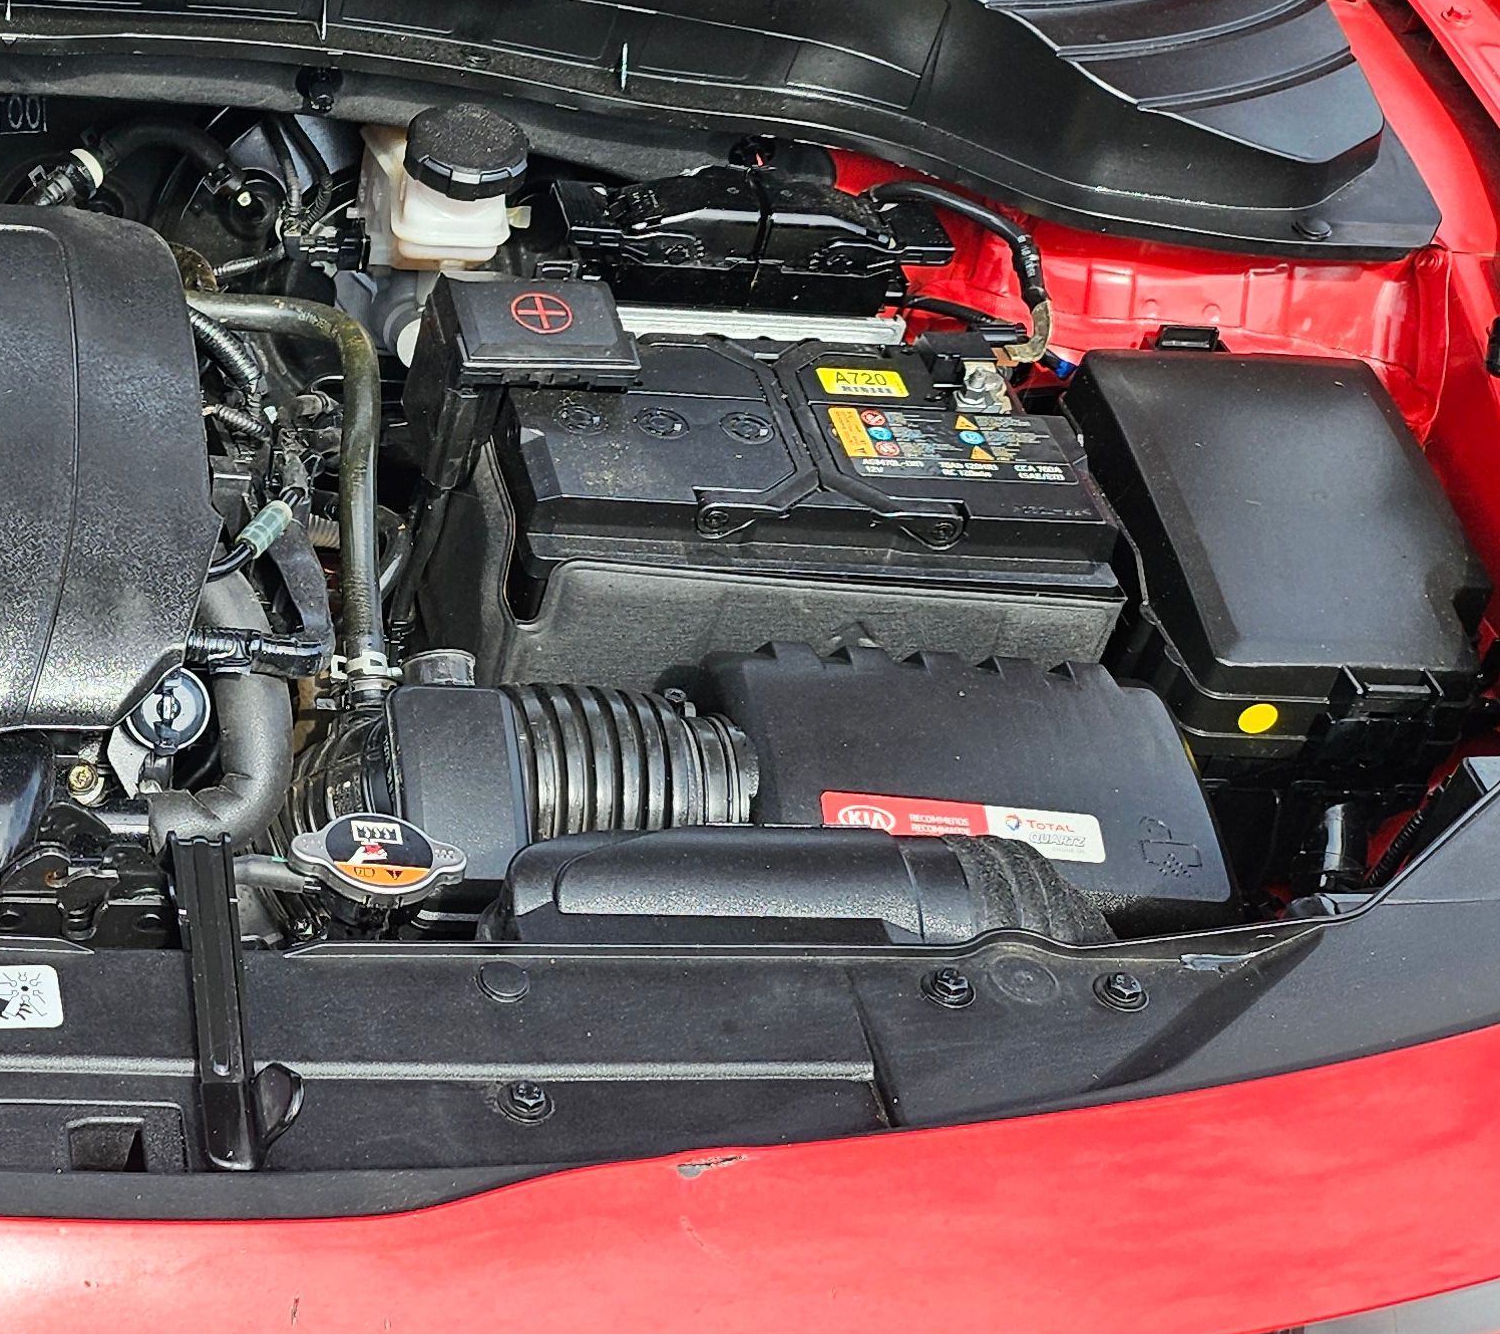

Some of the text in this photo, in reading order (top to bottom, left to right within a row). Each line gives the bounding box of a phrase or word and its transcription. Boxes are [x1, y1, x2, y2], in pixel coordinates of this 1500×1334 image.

[836, 372, 887, 385] A720
[847, 810, 888, 829] KIA
[1026, 819, 1075, 832] TOTAL
[1029, 832, 1086, 848] QUARTZ
